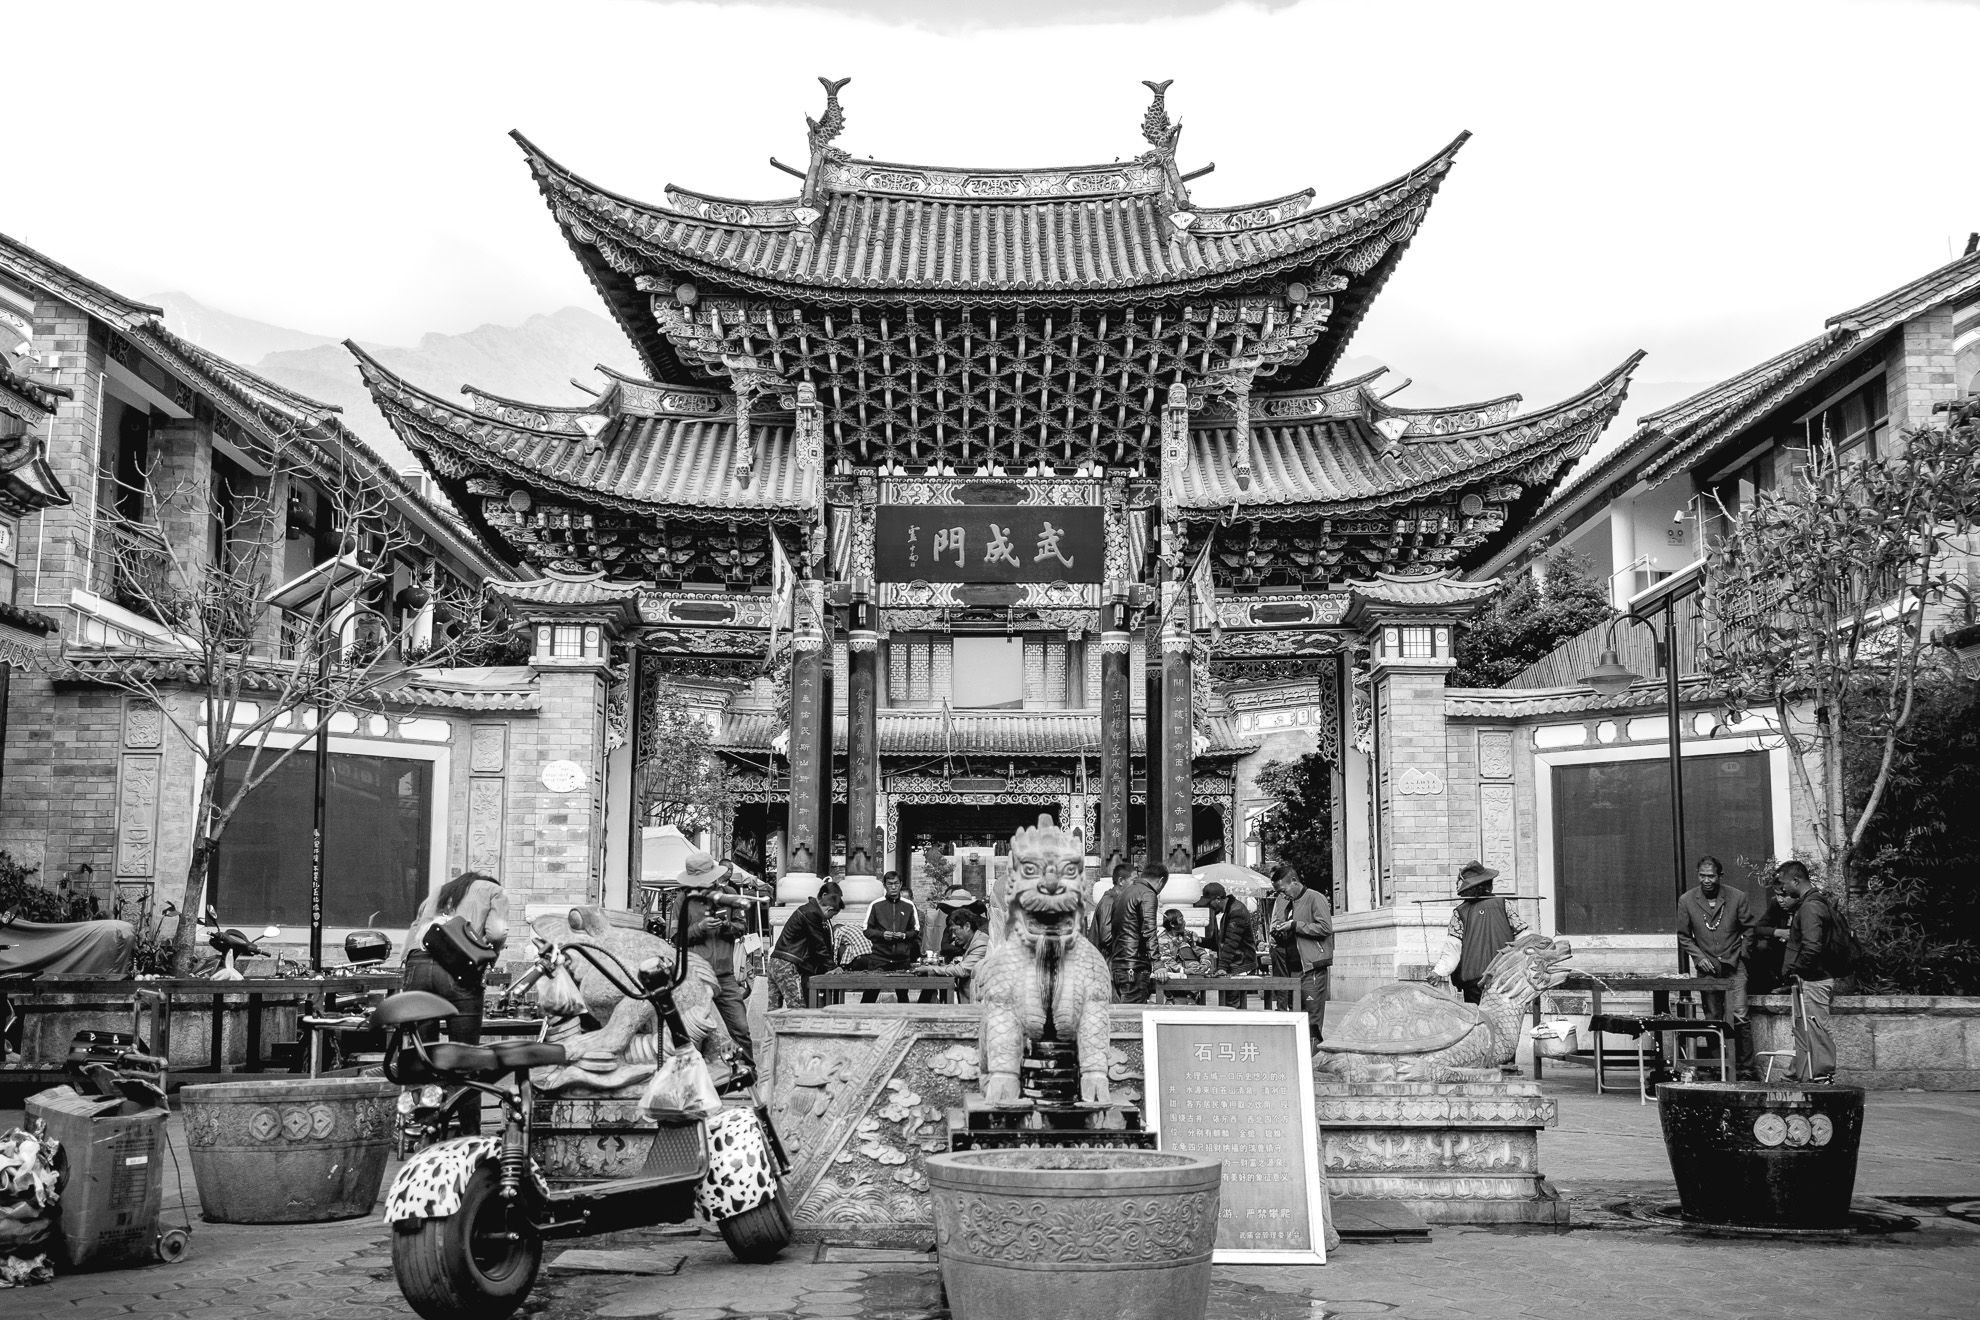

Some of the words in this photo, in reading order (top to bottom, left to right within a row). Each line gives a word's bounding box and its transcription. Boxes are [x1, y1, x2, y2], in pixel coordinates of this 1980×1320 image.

[932, 521, 1074, 569] 武成門
[1193, 1042, 1260, 1062] 石马井
[1185, 1072, 1287, 1081] 大理古城一口历史悠久的水
